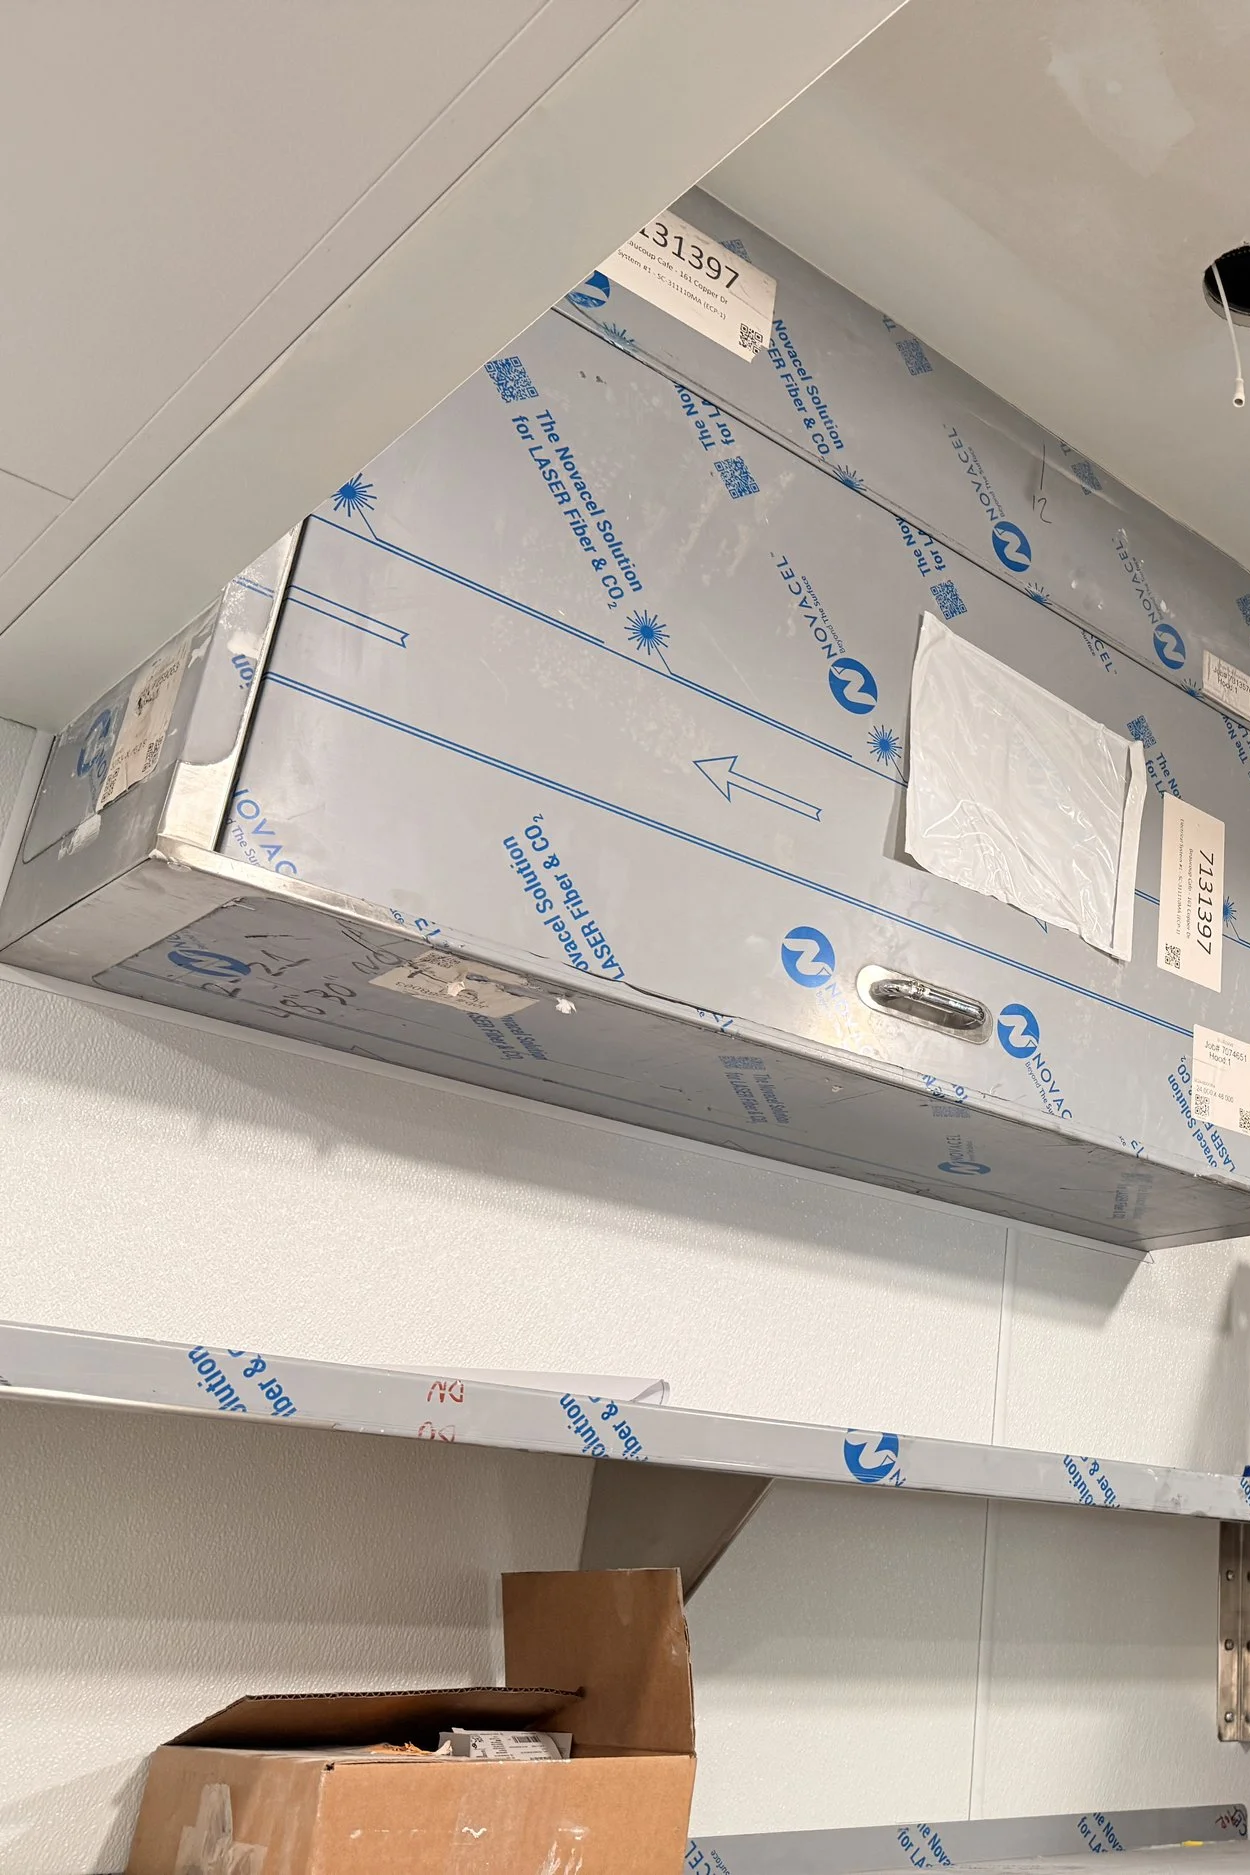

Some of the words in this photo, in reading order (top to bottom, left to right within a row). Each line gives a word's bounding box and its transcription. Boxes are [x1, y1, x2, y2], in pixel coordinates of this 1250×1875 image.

[617, 249, 642, 269] System
[628, 240, 656, 261] aucoup
[657, 255, 674, 271] Cafe
[680, 270, 693, 283] 161
[694, 279, 718, 300] Copper
[720, 294, 728, 305] Dr
[772, 319, 812, 382] Novacel
[806, 384, 845, 450] Solution
[780, 373, 808, 414] Fiber
[803, 417, 816, 430] &
[694, 419, 716, 451] The
[716, 422, 735, 446] for
[948, 427, 998, 521] NOVACEL
[512, 415, 535, 441] for
[528, 445, 571, 505] LASER
[563, 508, 597, 553] Fiber
[591, 558, 607, 572] &
[536, 409, 560, 443] The
[555, 446, 605, 517] Novacel
[596, 519, 643, 593] Solution
[913, 549, 931, 577] The
[929, 550, 946, 572] for
[801, 575, 821, 607] Surface
[1115, 540, 1159, 624] NOVACEL
[776, 555, 838, 660] NOVACEL
[818, 608, 829, 625] The
[828, 624, 846, 654] Beyond
[1145, 759, 1160, 779] for
[1155, 752, 1171, 772] The
[1235, 742, 1248, 765] The
[232, 825, 248, 848] The
[502, 835, 553, 914] Solution
[543, 853, 561, 869] &
[554, 873, 590, 921] Fiber
[1196, 849, 1214, 955] 7131397
[580, 919, 626, 981] LASER
[1209, 1051, 1226, 1065] Hood
[1025, 1062, 1041, 1089] Beyond
[1039, 1088, 1049, 1104] The
[1167, 1074, 1197, 1128] Solution
[1210, 1128, 1237, 1173] LASER
[243, 1353, 267, 1378] &
[600, 1400, 619, 1421] &
[1089, 1459, 1100, 1476] &
[897, 1827, 914, 1852] for
[1077, 1816, 1092, 1838] for
